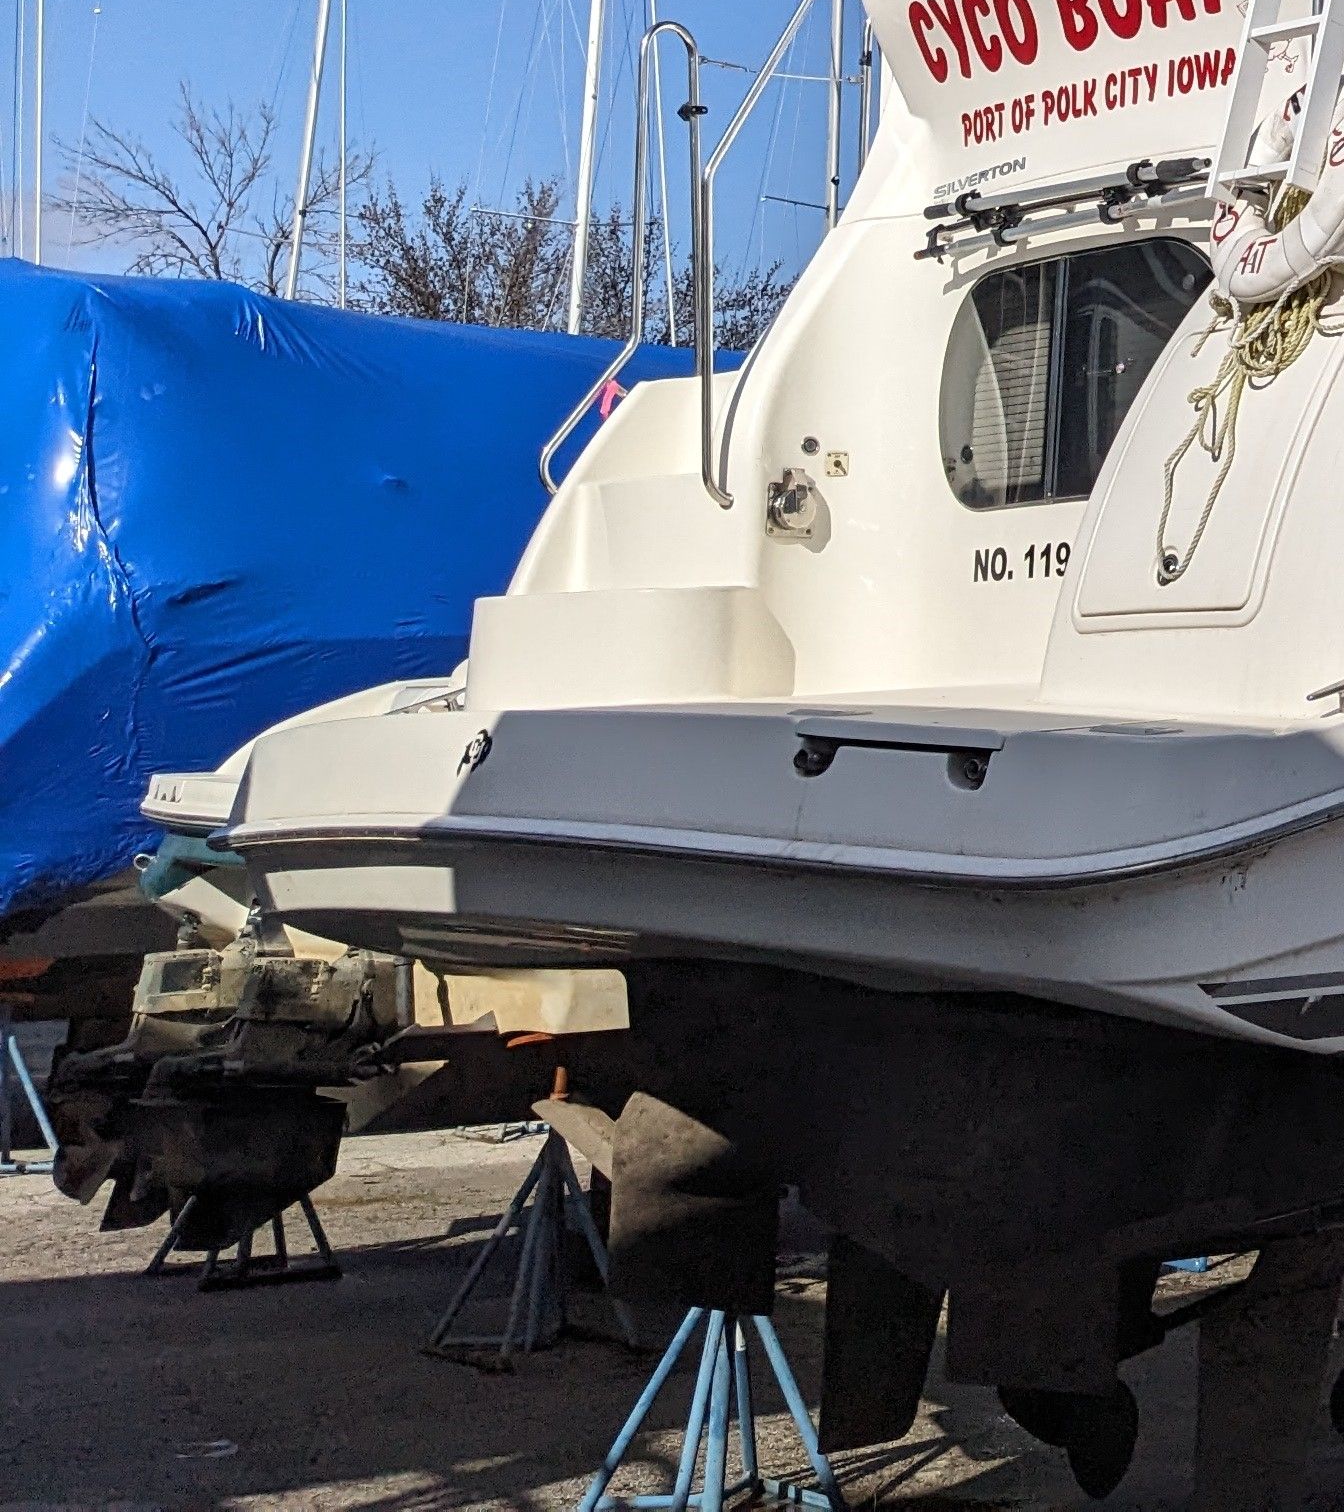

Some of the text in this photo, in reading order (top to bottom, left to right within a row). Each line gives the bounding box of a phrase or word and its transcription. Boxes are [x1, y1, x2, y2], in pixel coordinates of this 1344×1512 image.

[961, 47, 1237, 148] PORT OF POLK CITY IOWA
[934, 156, 1027, 199] SILVERTON
[973, 541, 1072, 583] NO. 119
